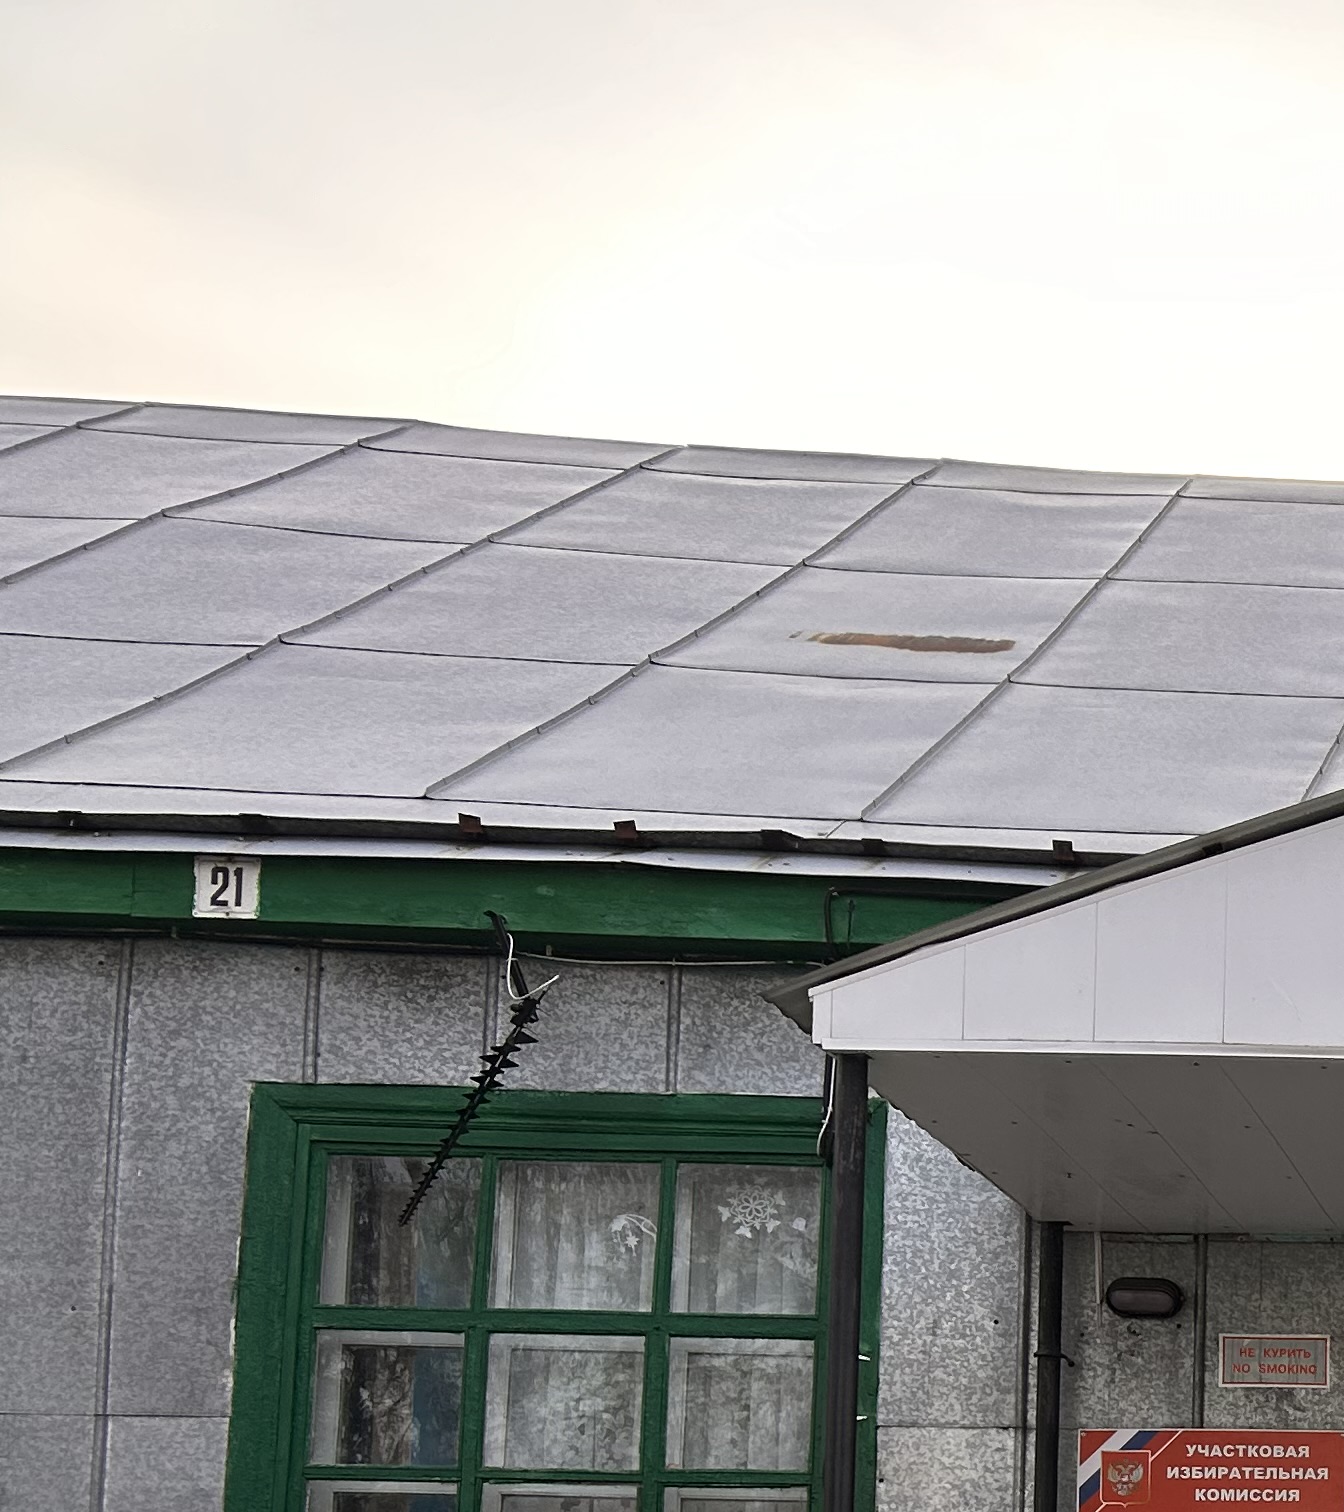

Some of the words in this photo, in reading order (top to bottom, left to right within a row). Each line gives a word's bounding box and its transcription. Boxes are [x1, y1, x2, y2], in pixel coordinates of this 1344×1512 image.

[210, 866, 243, 907] 21
[1239, 1348, 1255, 1358] НЕ
[1263, 1348, 1311, 1359] КУРИТЬ
[1232, 1364, 1251, 1374] NO
[1186, 1443, 1310, 1458] УЧАСТКОВАЯ
[1166, 1466, 1329, 1480] ИЗБИРАТЕЛЬНАЯ
[1195, 1488, 1300, 1502] КОМИССИЯ
